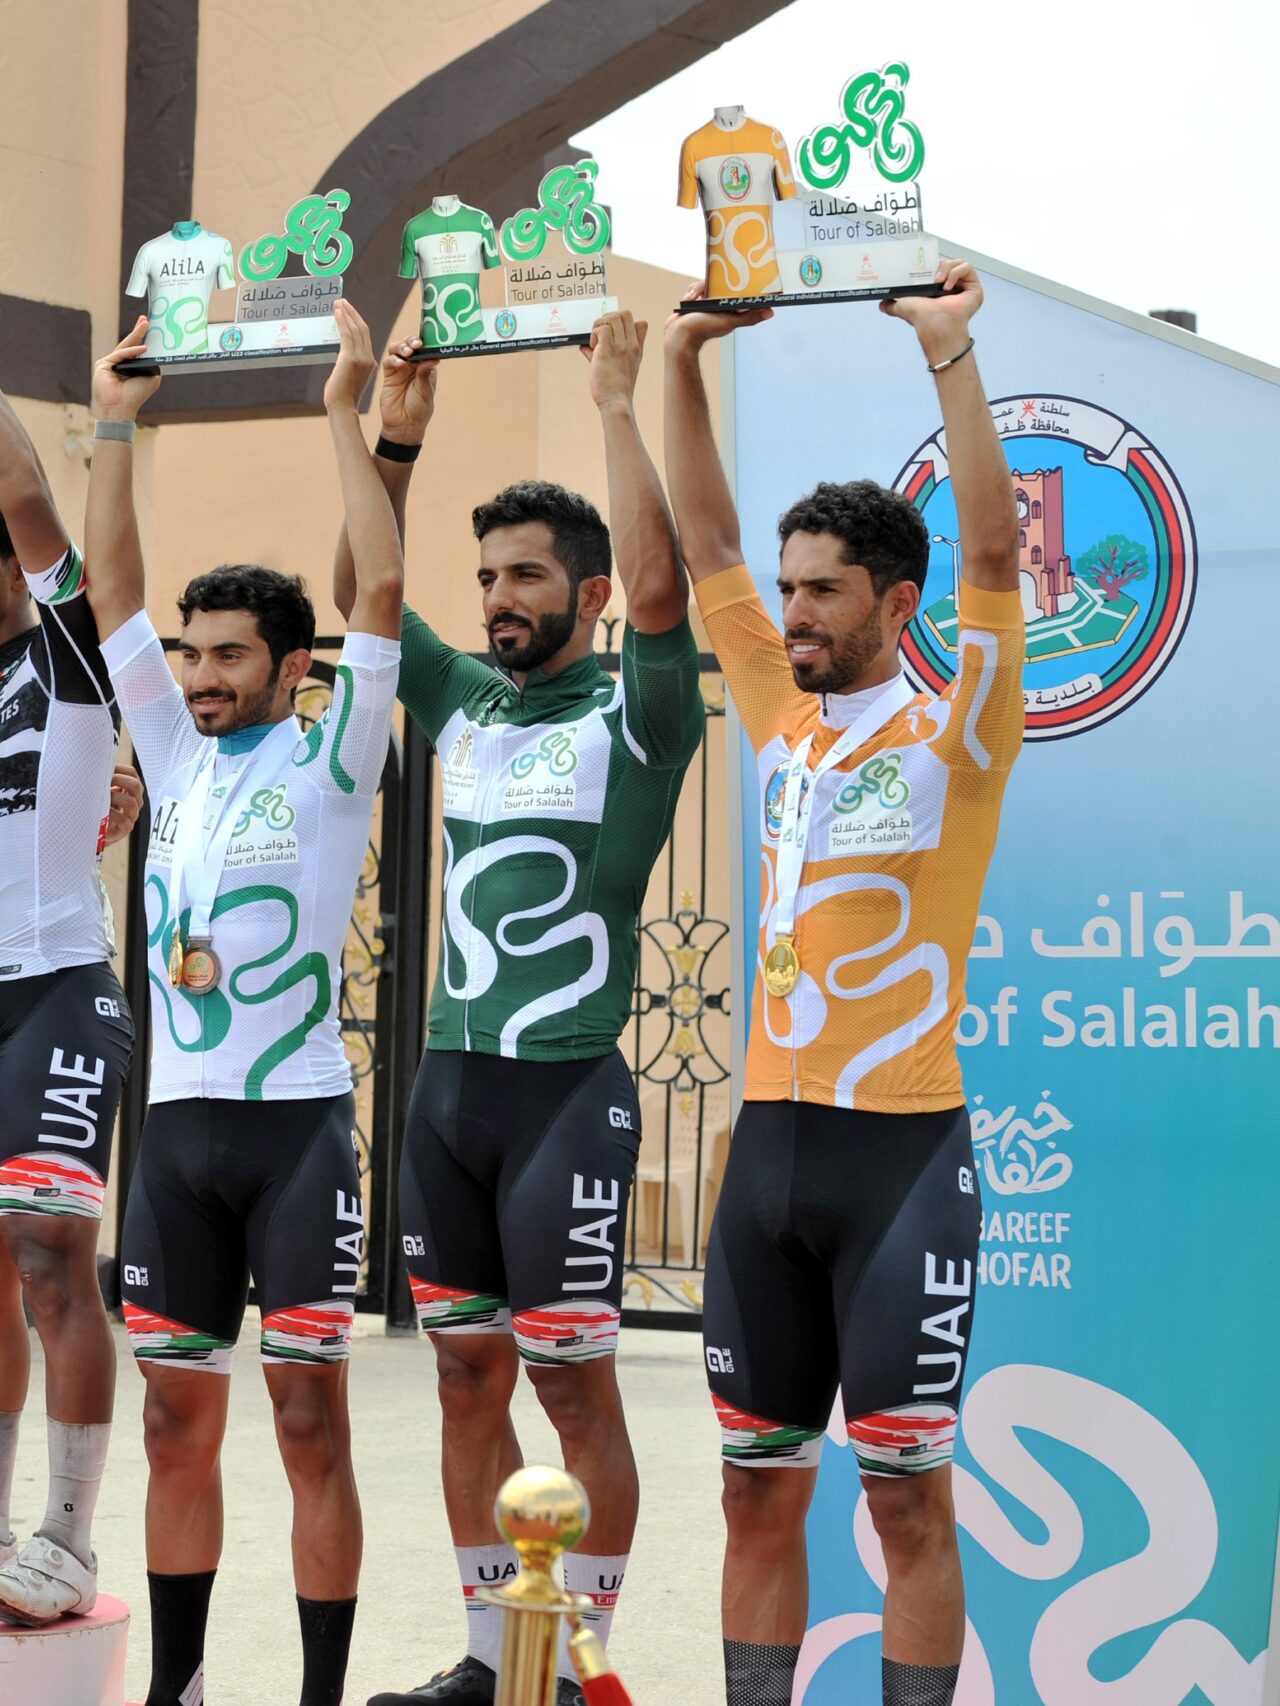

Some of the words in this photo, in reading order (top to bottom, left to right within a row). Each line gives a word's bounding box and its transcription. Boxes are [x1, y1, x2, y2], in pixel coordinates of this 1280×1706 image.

[810, 225, 841, 241] Tour
[846, 222, 862, 239] of
[866, 217, 920, 237] Salalah
[511, 289, 536, 302] Tour
[542, 285, 553, 299] of
[558, 282, 604, 298] Salalah
[242, 306, 268, 319] Tour
[273, 303, 286, 316] of
[504, 801, 521, 809] Tour
[524, 798, 533, 807] of
[536, 798, 573, 808] Salalah
[831, 835, 854, 847] Tour
[856, 833, 868, 845] of
[870, 830, 911, 844] Salalah
[224, 858, 246, 868] Tour
[246, 855, 257, 865] of
[260, 851, 297, 862] Salalah
[957, 986, 1018, 1047] of
[1041, 986, 1280, 1048] Salalah
[38, 1047, 105, 1149] UAE
[331, 1189, 365, 1294] UAE
[562, 1173, 619, 1291] UAE
[978, 1210, 1072, 1244] AREEF
[977, 1251, 1073, 1290] HOFAR
[912, 1250, 971, 1395] UAE
